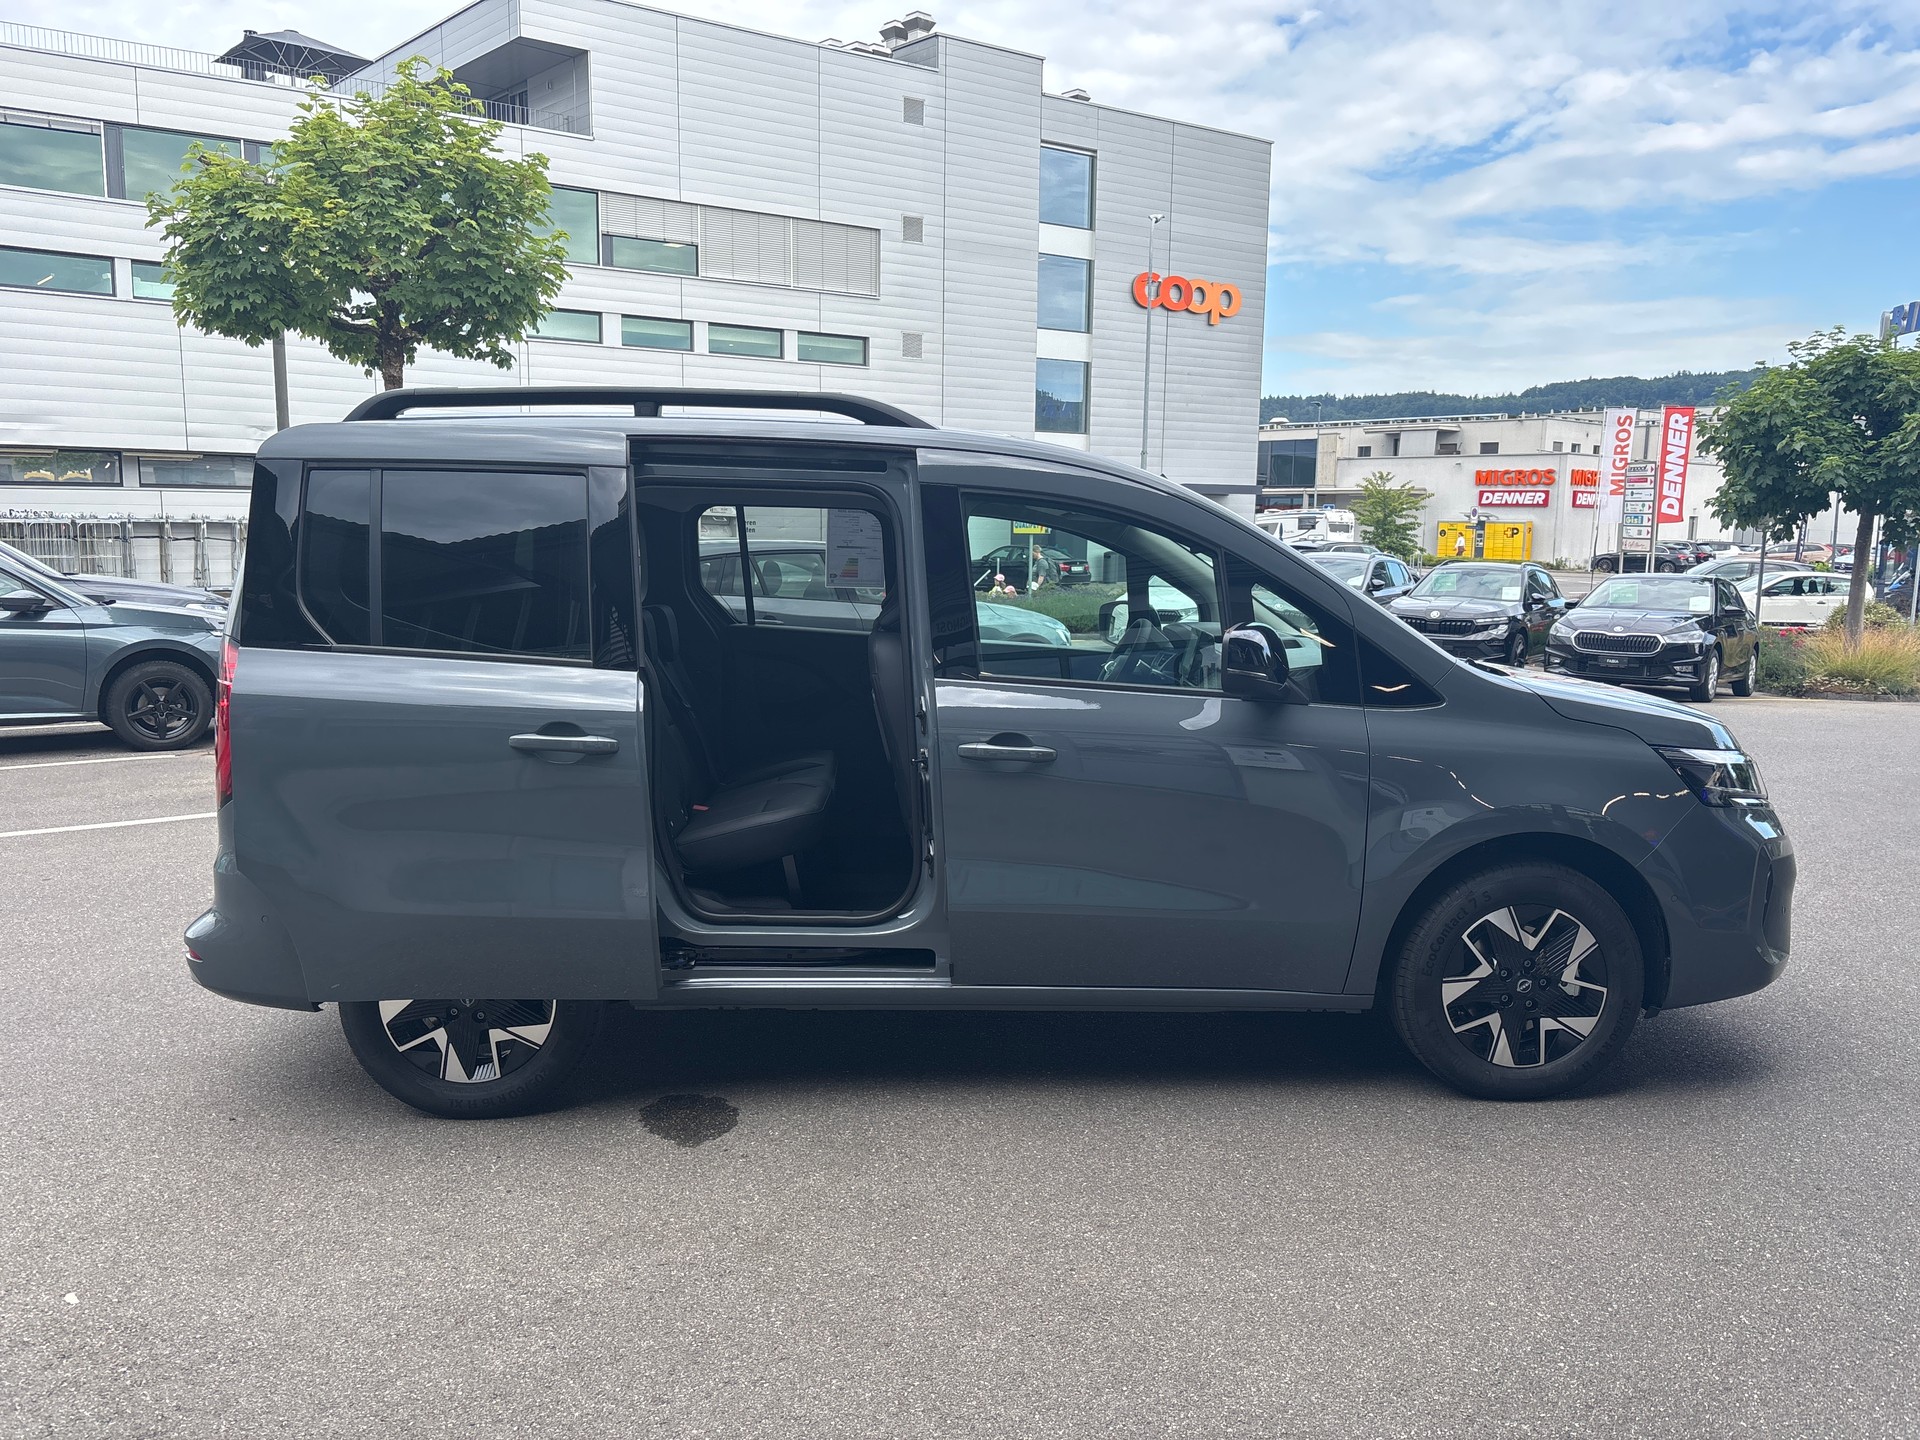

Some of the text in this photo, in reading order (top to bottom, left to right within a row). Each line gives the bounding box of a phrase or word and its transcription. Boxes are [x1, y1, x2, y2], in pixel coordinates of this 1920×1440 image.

[1132, 271, 1242, 325] coop
[1475, 468, 1557, 486] MIGROS
[1609, 415, 1633, 495] MIGROS
[1661, 413, 1689, 516] DENNER
[1480, 492, 1546, 505] DENNER
[1421, 889, 1492, 976] EcoContact 7 S
